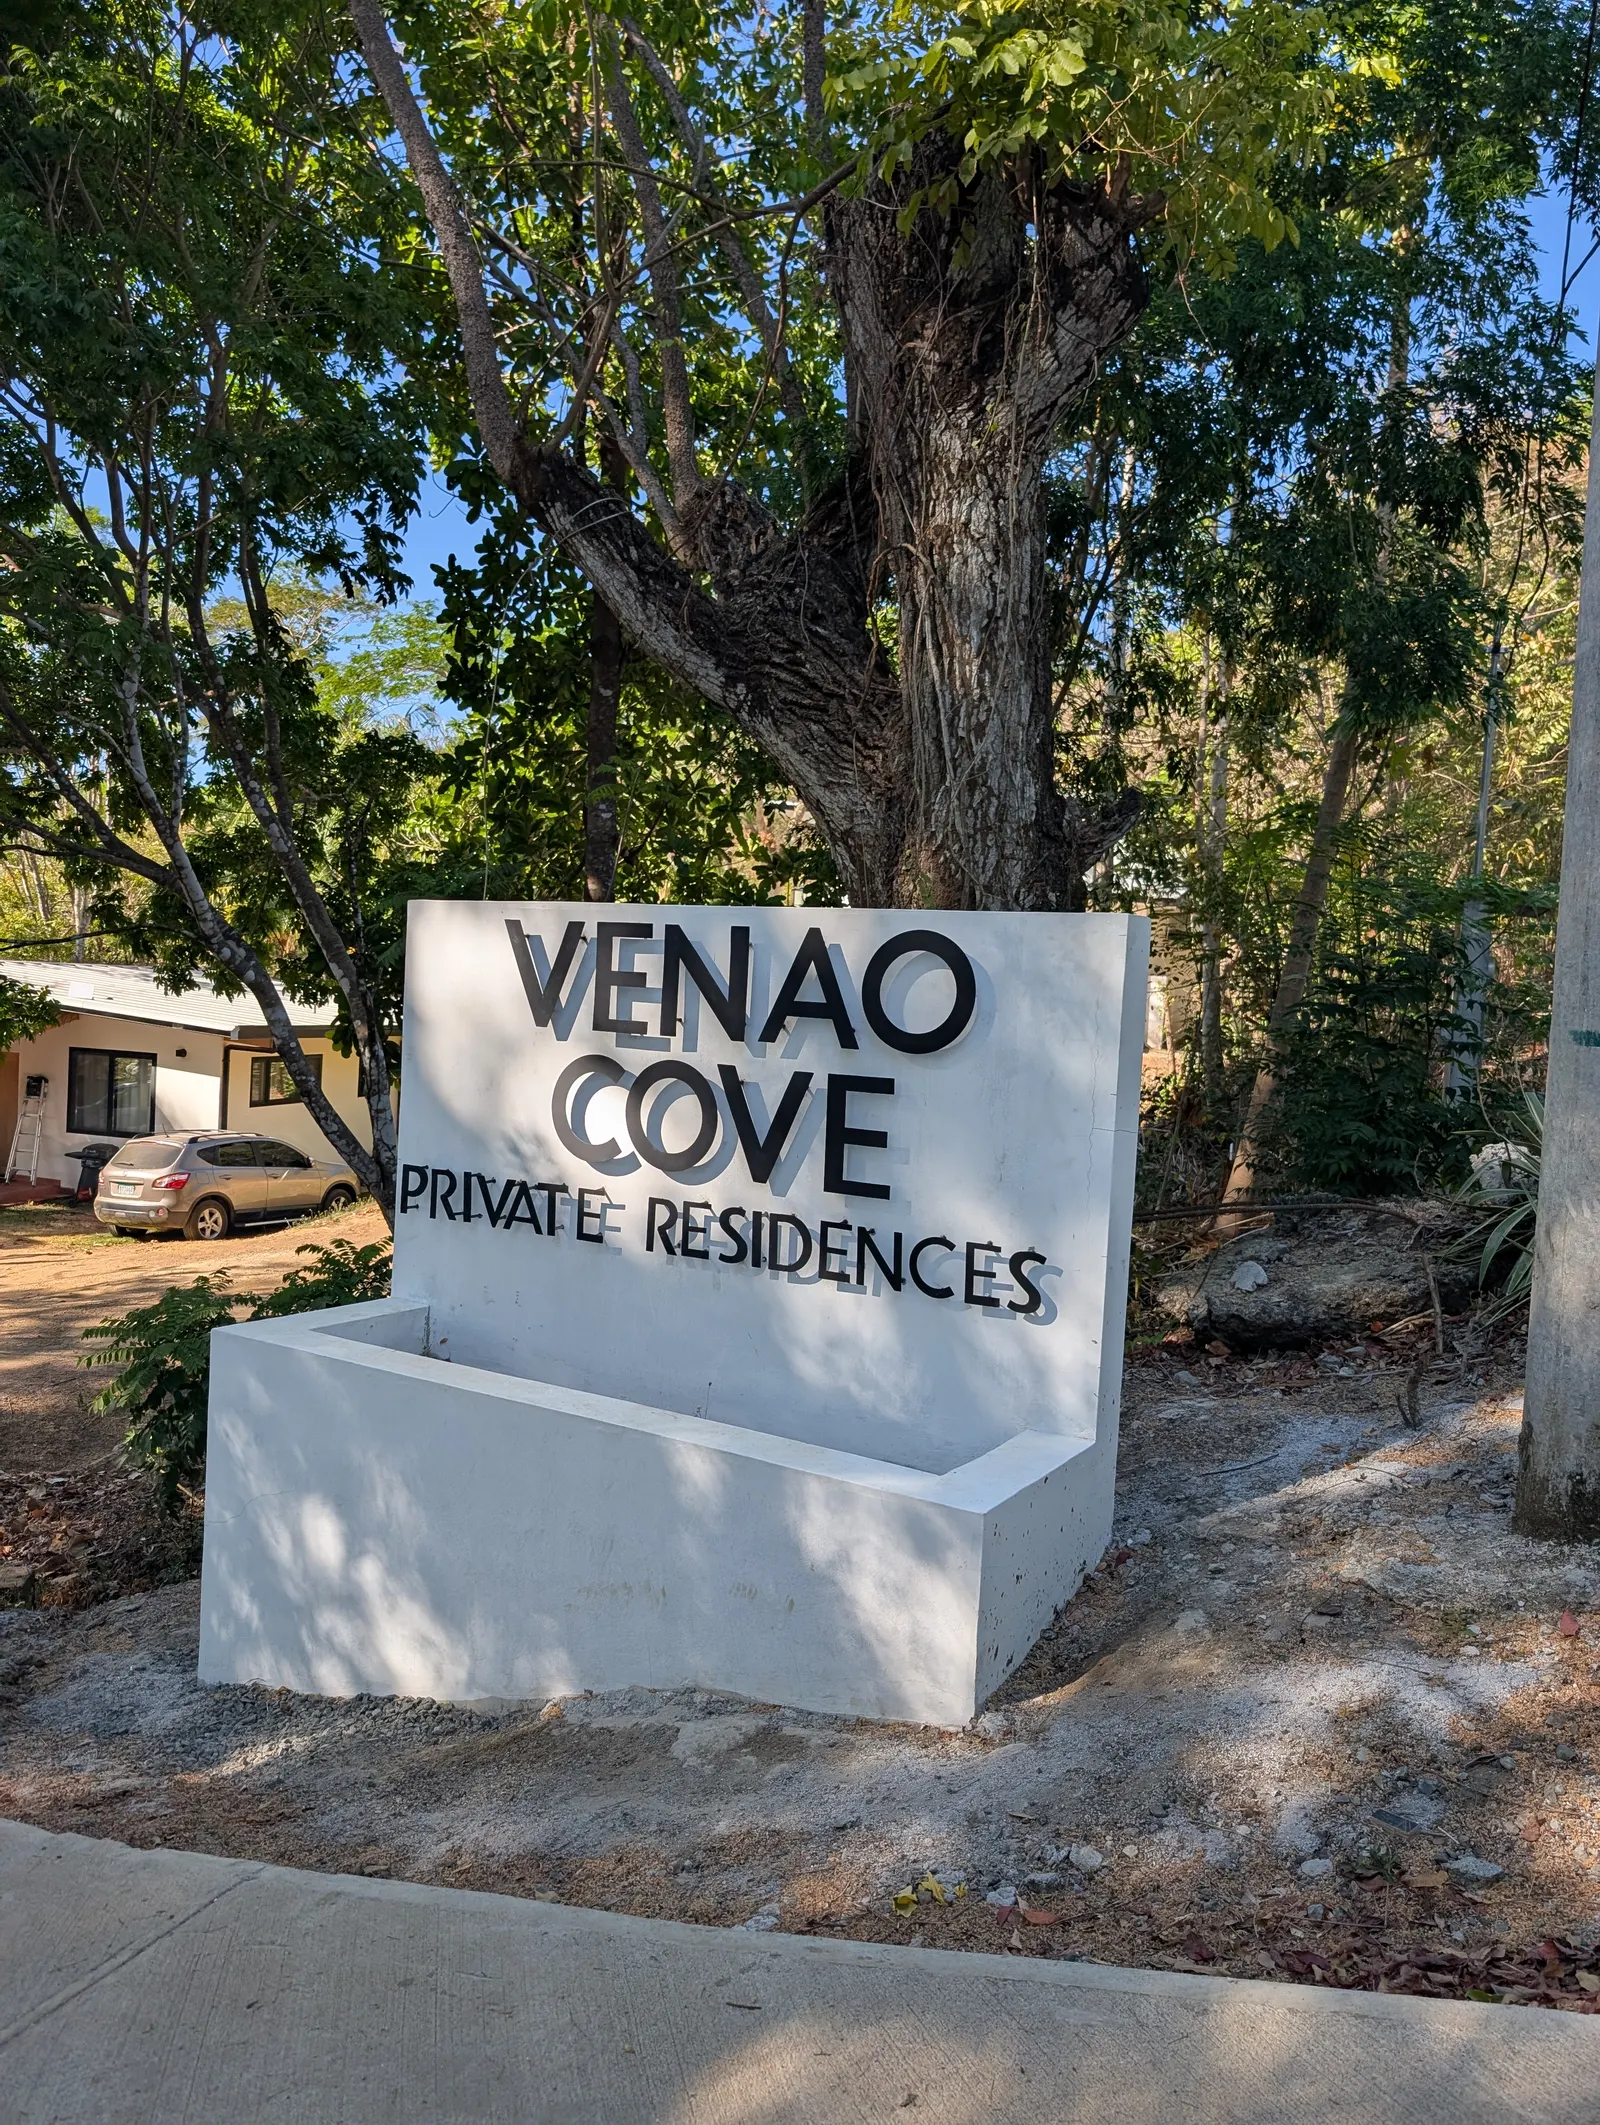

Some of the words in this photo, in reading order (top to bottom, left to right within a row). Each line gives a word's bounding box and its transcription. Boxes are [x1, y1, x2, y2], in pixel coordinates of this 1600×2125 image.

[506, 919, 976, 1055] VENAO
[552, 1054, 895, 1200] COVE
[401, 1163, 606, 1244] PRIVATE
[646, 1197, 1047, 1314] RESIDENCES
